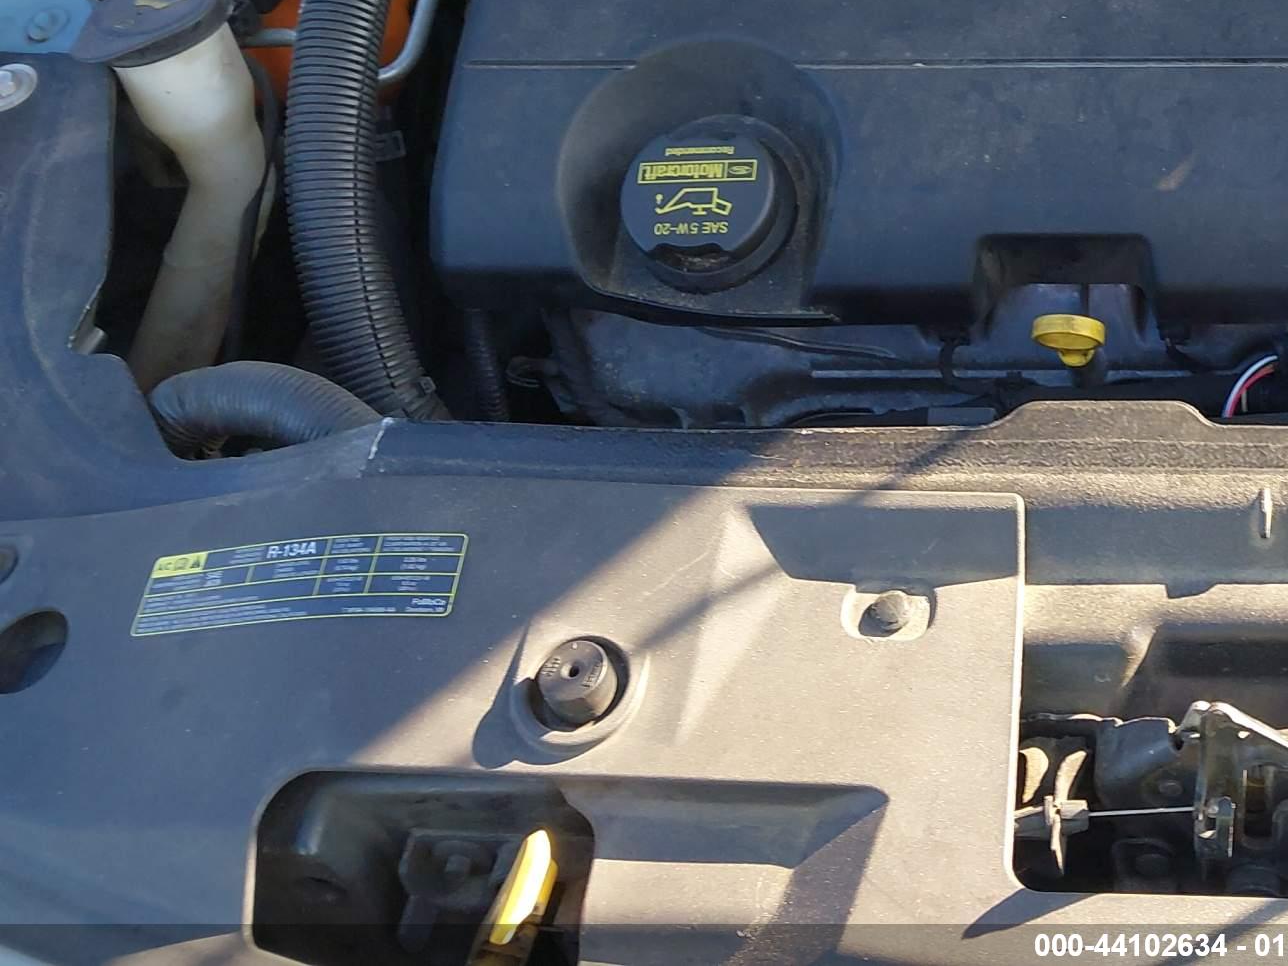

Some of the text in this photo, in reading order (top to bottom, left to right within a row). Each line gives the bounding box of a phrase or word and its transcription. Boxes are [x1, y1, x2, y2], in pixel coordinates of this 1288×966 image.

[643, 163, 724, 181] Motorcraft
[701, 221, 729, 234] SAE
[266, 541, 317, 559] R-134A
